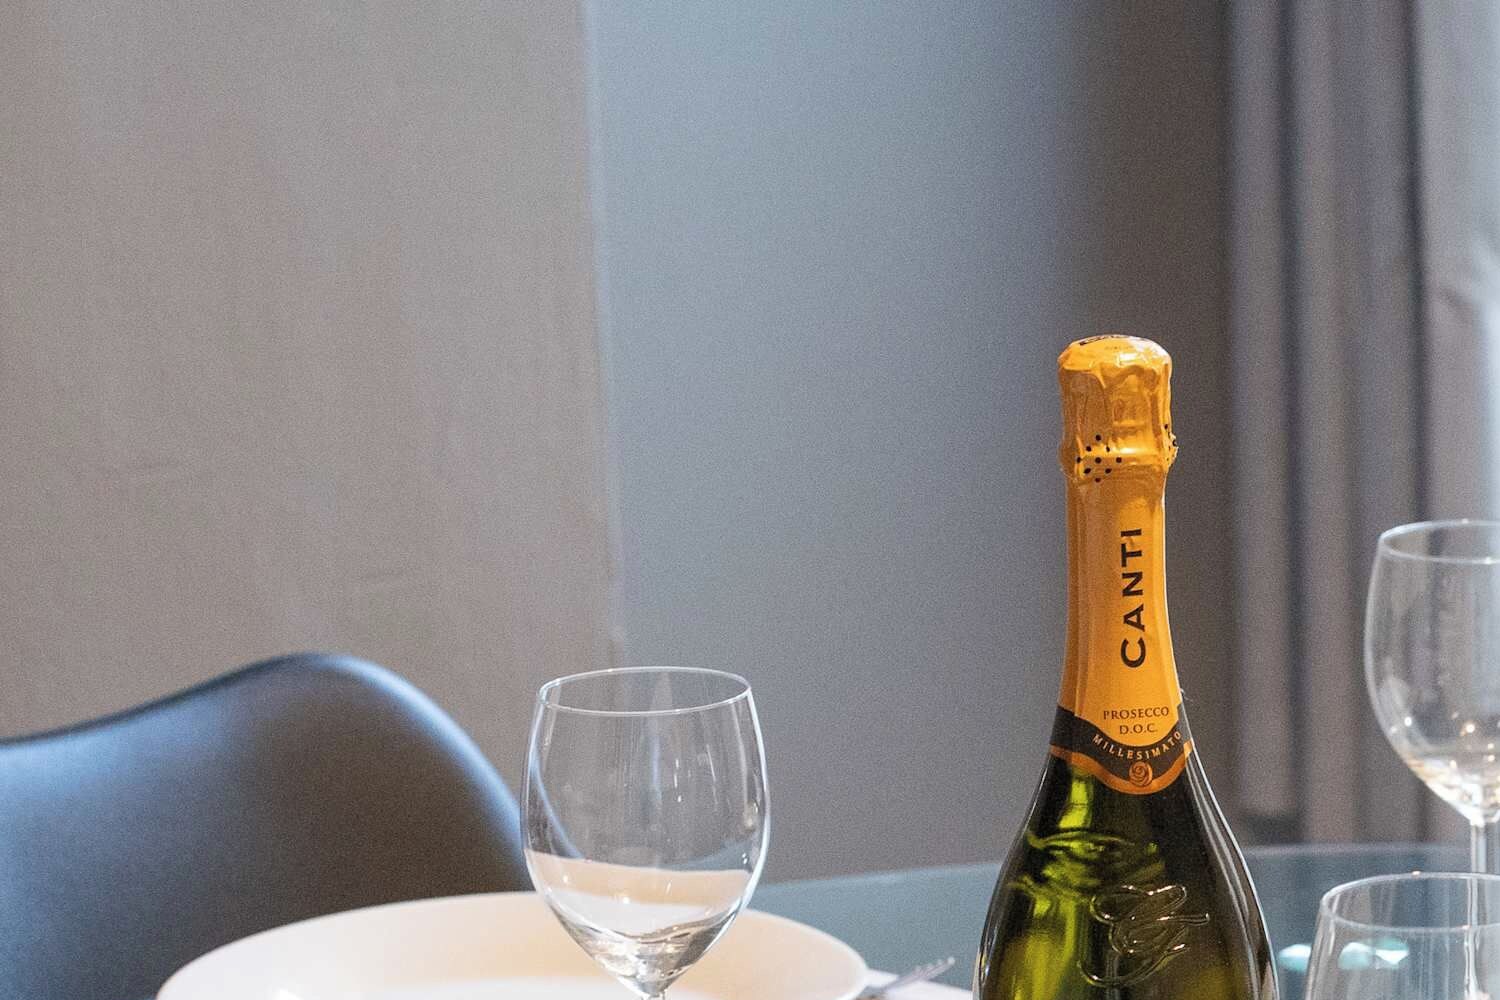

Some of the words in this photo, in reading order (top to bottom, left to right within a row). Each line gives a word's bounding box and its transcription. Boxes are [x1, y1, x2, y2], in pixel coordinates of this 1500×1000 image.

[1120, 528, 1147, 668] CANTI
[1103, 706, 1170, 721] PROSECCO
[1119, 723, 1158, 735] D.O.C.
[1092, 730, 1182, 761] MILLESIMATO
